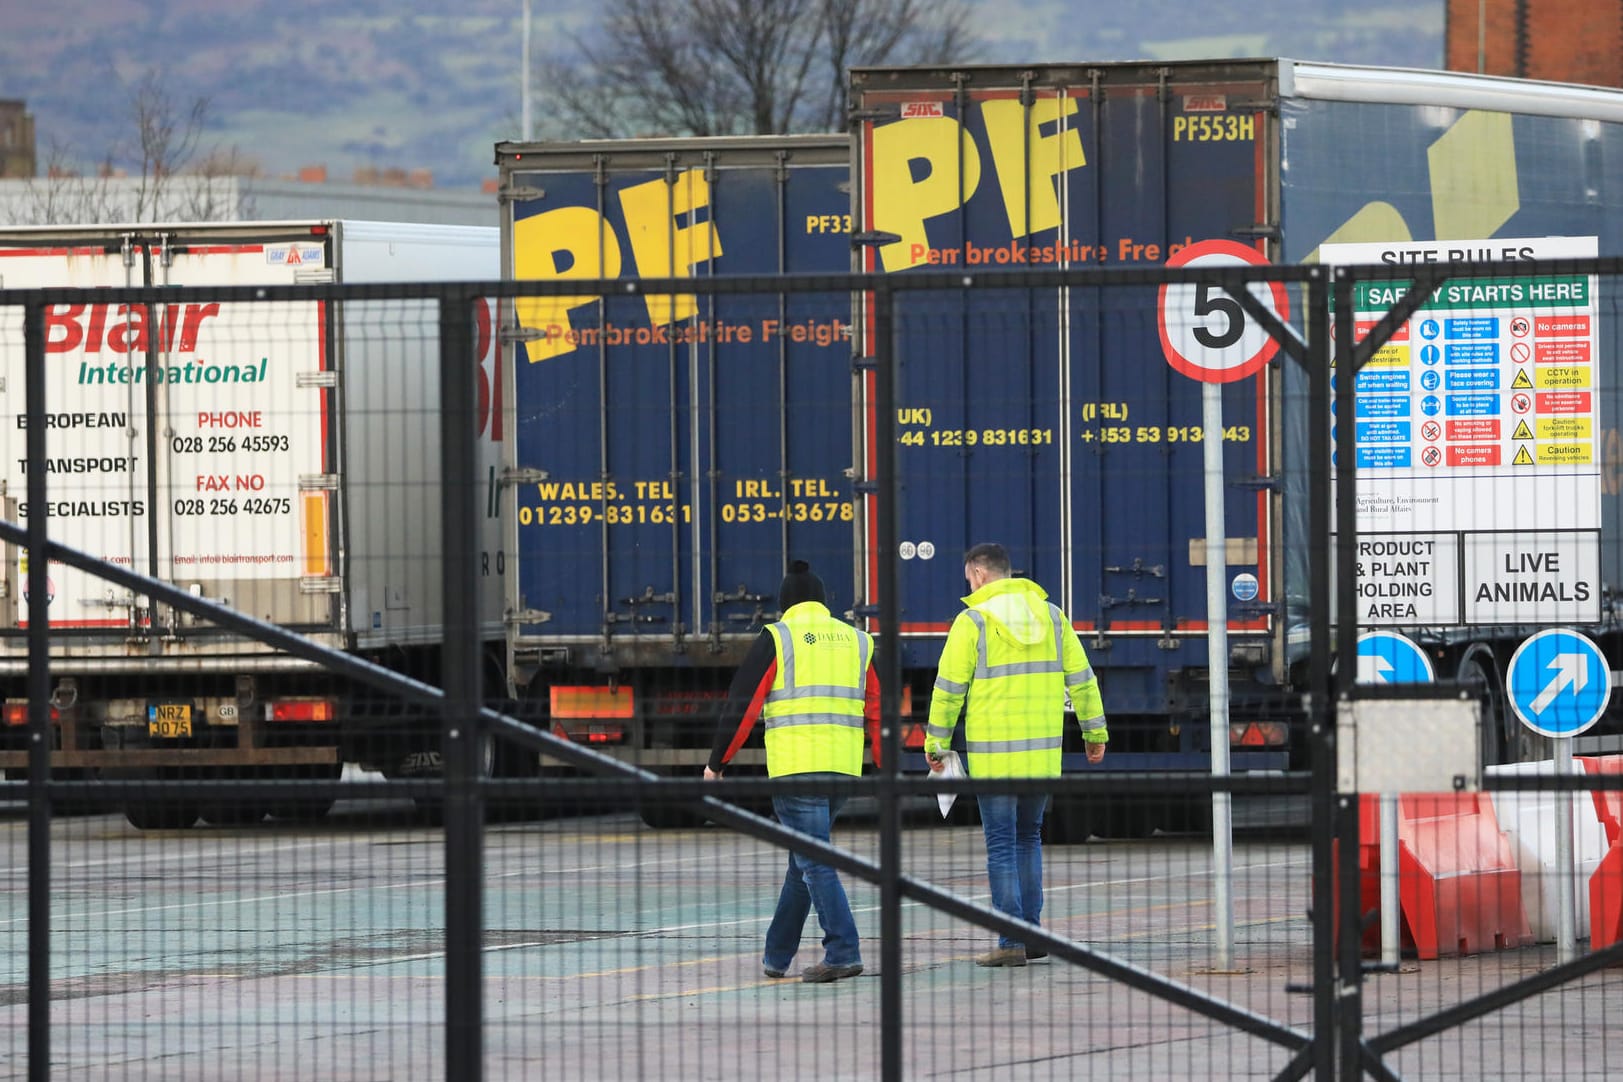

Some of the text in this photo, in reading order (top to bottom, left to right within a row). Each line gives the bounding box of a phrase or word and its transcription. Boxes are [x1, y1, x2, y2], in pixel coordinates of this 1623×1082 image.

[1174, 115, 1254, 141] PF553H
[1369, 282, 1583, 305] SAFY STARTS HERE
[44, 285, 220, 354] Blair
[1192, 278, 1245, 349] 5
[1538, 323, 1587, 331] No cameras
[1547, 368, 1569, 376] CCTV
[1544, 377, 1582, 386] operation
[17, 412, 126, 429] EROPEAN
[198, 411, 262, 428] PHONE
[897, 408, 932, 427] UK)
[931, 430, 978, 445] 1239
[982, 429, 1052, 445] 831631
[1136, 427, 1160, 442] 53
[173, 435, 289, 453] 028 256 45593
[1547, 446, 1581, 454] Caution
[18, 457, 138, 474] TANSPORT
[1460, 456, 1487, 464] phones
[196, 474, 265, 491] FAX NO
[538, 481, 624, 500] WALES.
[736, 479, 839, 498] IRL. TEL.
[175, 498, 291, 515] 028 256 42675
[1396, 496, 1439, 504] Environment
[18, 501, 145, 518] SECIALISTS
[1370, 505, 1389, 513] Rural
[1391, 505, 1412, 513] Affairs
[1371, 561, 1430, 577] PLANT
[1505, 552, 1560, 573] LIVE
[1475, 581, 1590, 602] ANIMALS
[1367, 603, 1418, 618] AREA
[158, 706, 185, 720] NRZ
[219, 707, 235, 717] GB
